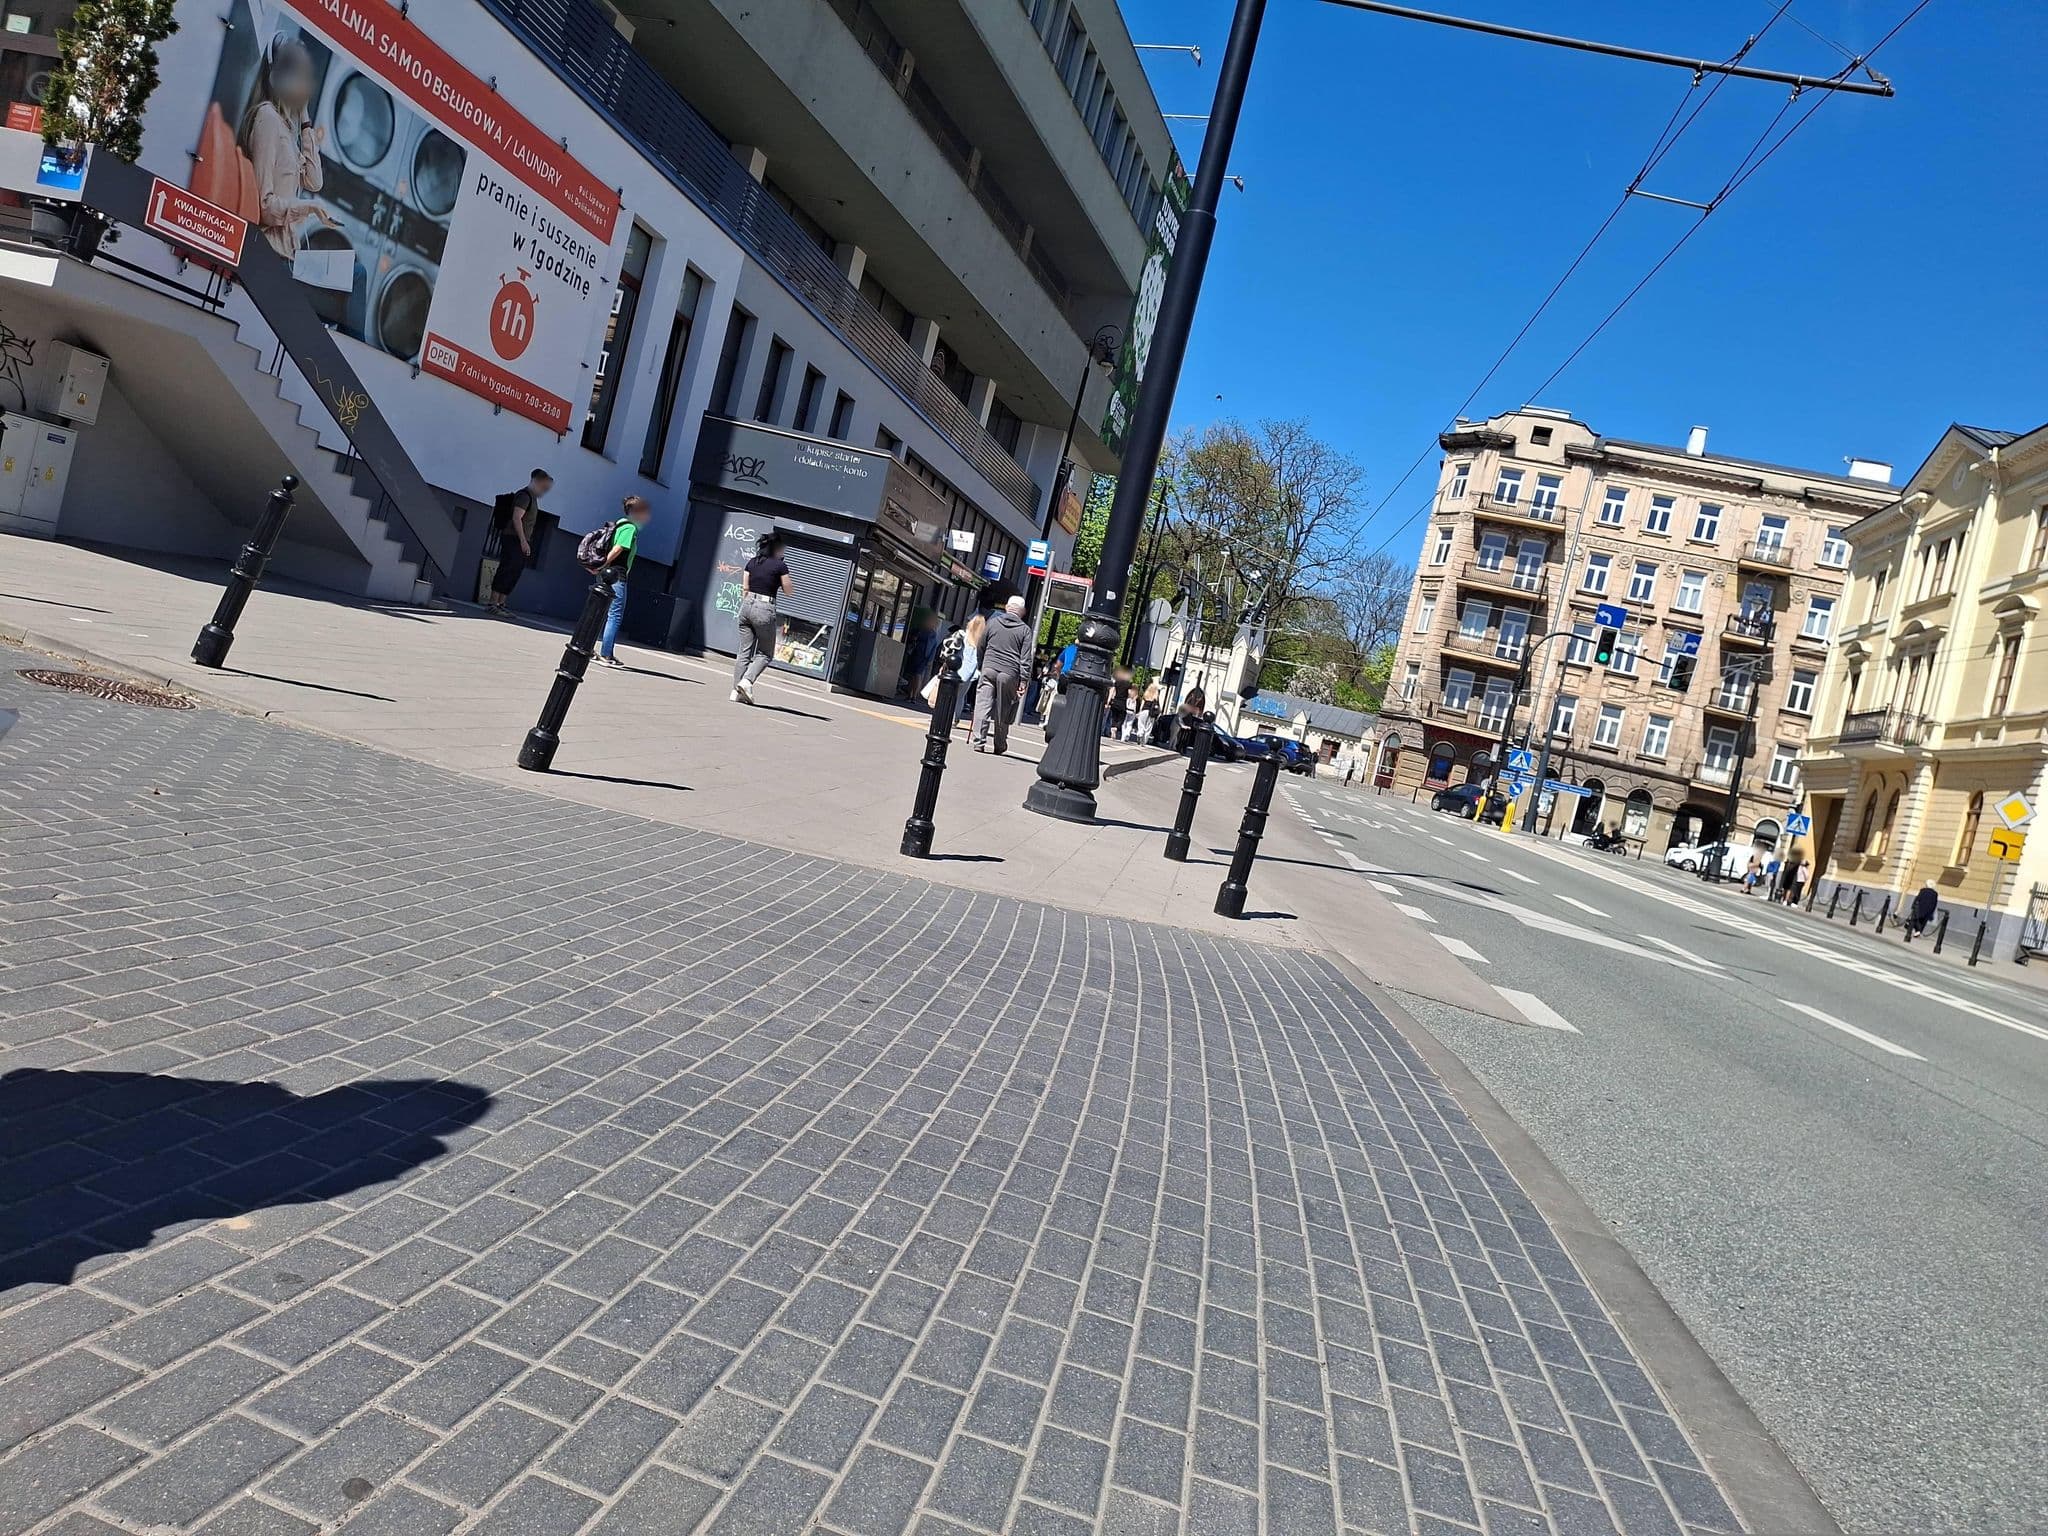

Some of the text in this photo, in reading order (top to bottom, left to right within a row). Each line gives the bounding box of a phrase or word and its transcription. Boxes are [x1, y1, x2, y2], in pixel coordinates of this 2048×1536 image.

[379, 34, 502, 144] SAMOOBSŁUGOWA
[512, 139, 563, 188] LAUNDRY
[174, 198, 235, 234] KWALIFIKACJA
[177, 214, 226, 245] WOJSKOWA
[476, 173, 597, 269] pranie i suszenie
[512, 231, 526, 252] w
[500, 299, 527, 341] 1h
[430, 346, 456, 369] OPEN
[460, 361, 467, 373] 7
[466, 365, 480, 380] dni
[480, 374, 488, 384] w
[488, 377, 522, 401] tygodniu
[806, 445, 834, 458] kupisz
[843, 465, 868, 478] konto
[724, 524, 756, 542] AGS
